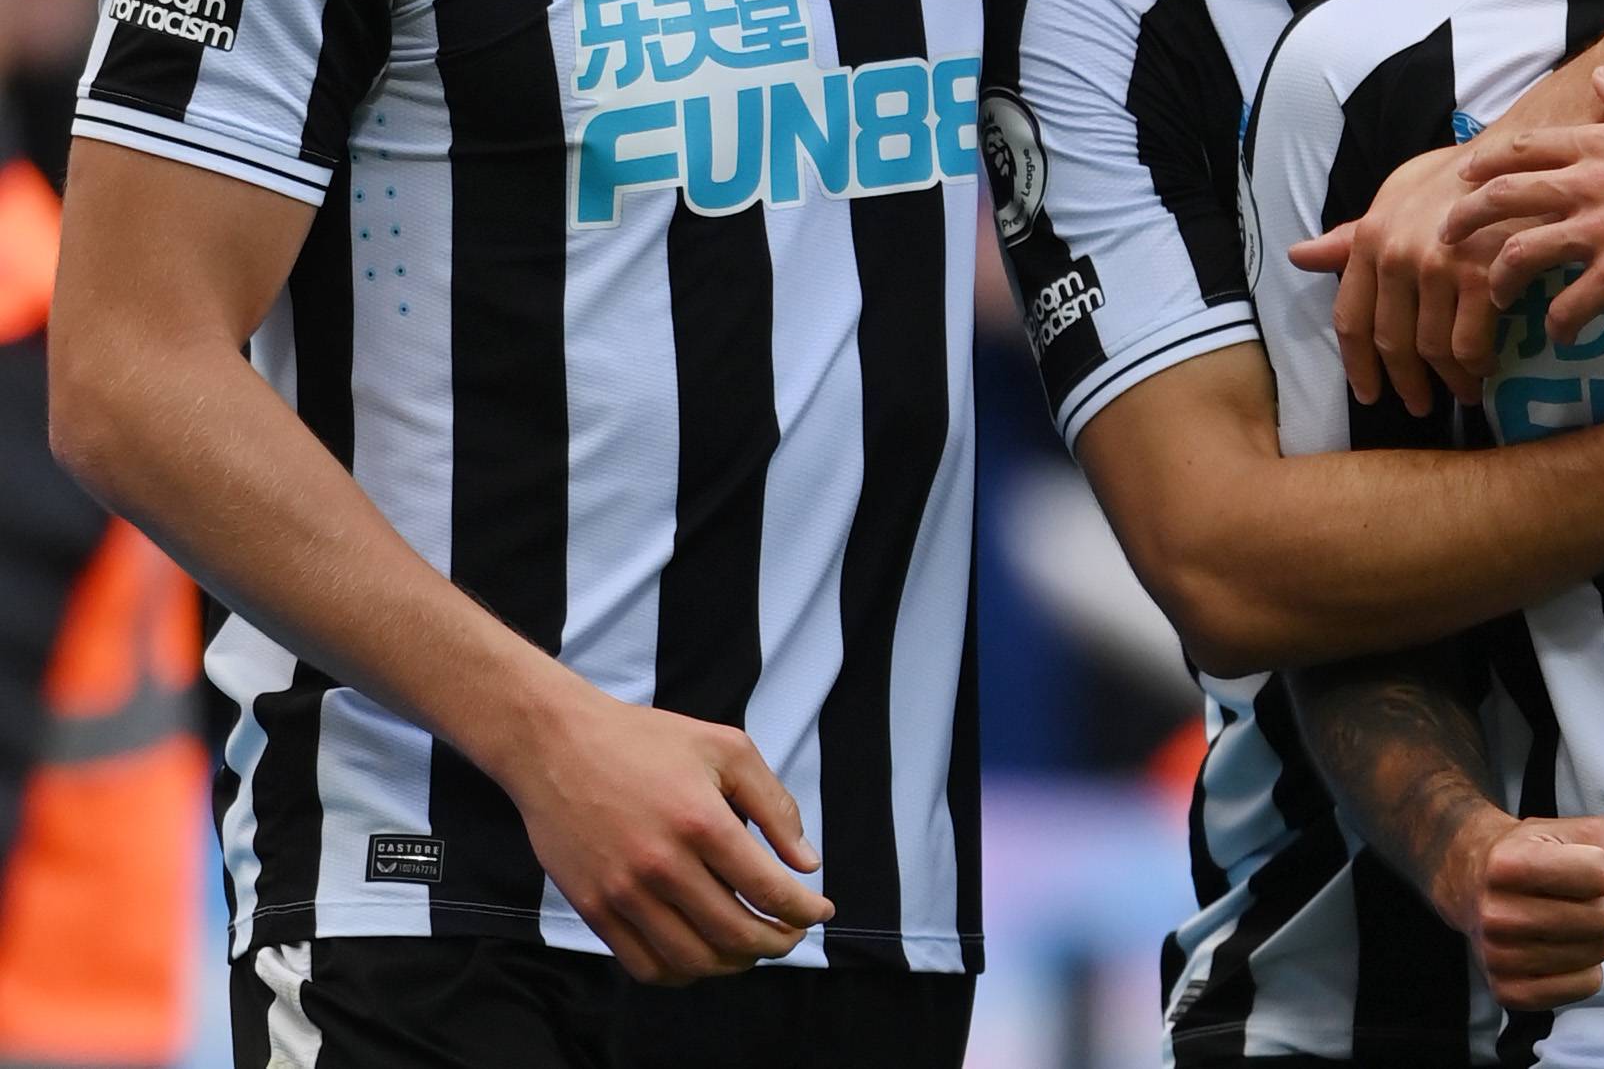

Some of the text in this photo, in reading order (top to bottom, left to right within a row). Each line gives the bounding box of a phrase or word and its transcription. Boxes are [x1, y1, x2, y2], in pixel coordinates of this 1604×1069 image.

[137, 3, 235, 51] racism
[1021, 148, 1036, 198] League
[377, 843, 440, 855] CASTORE
